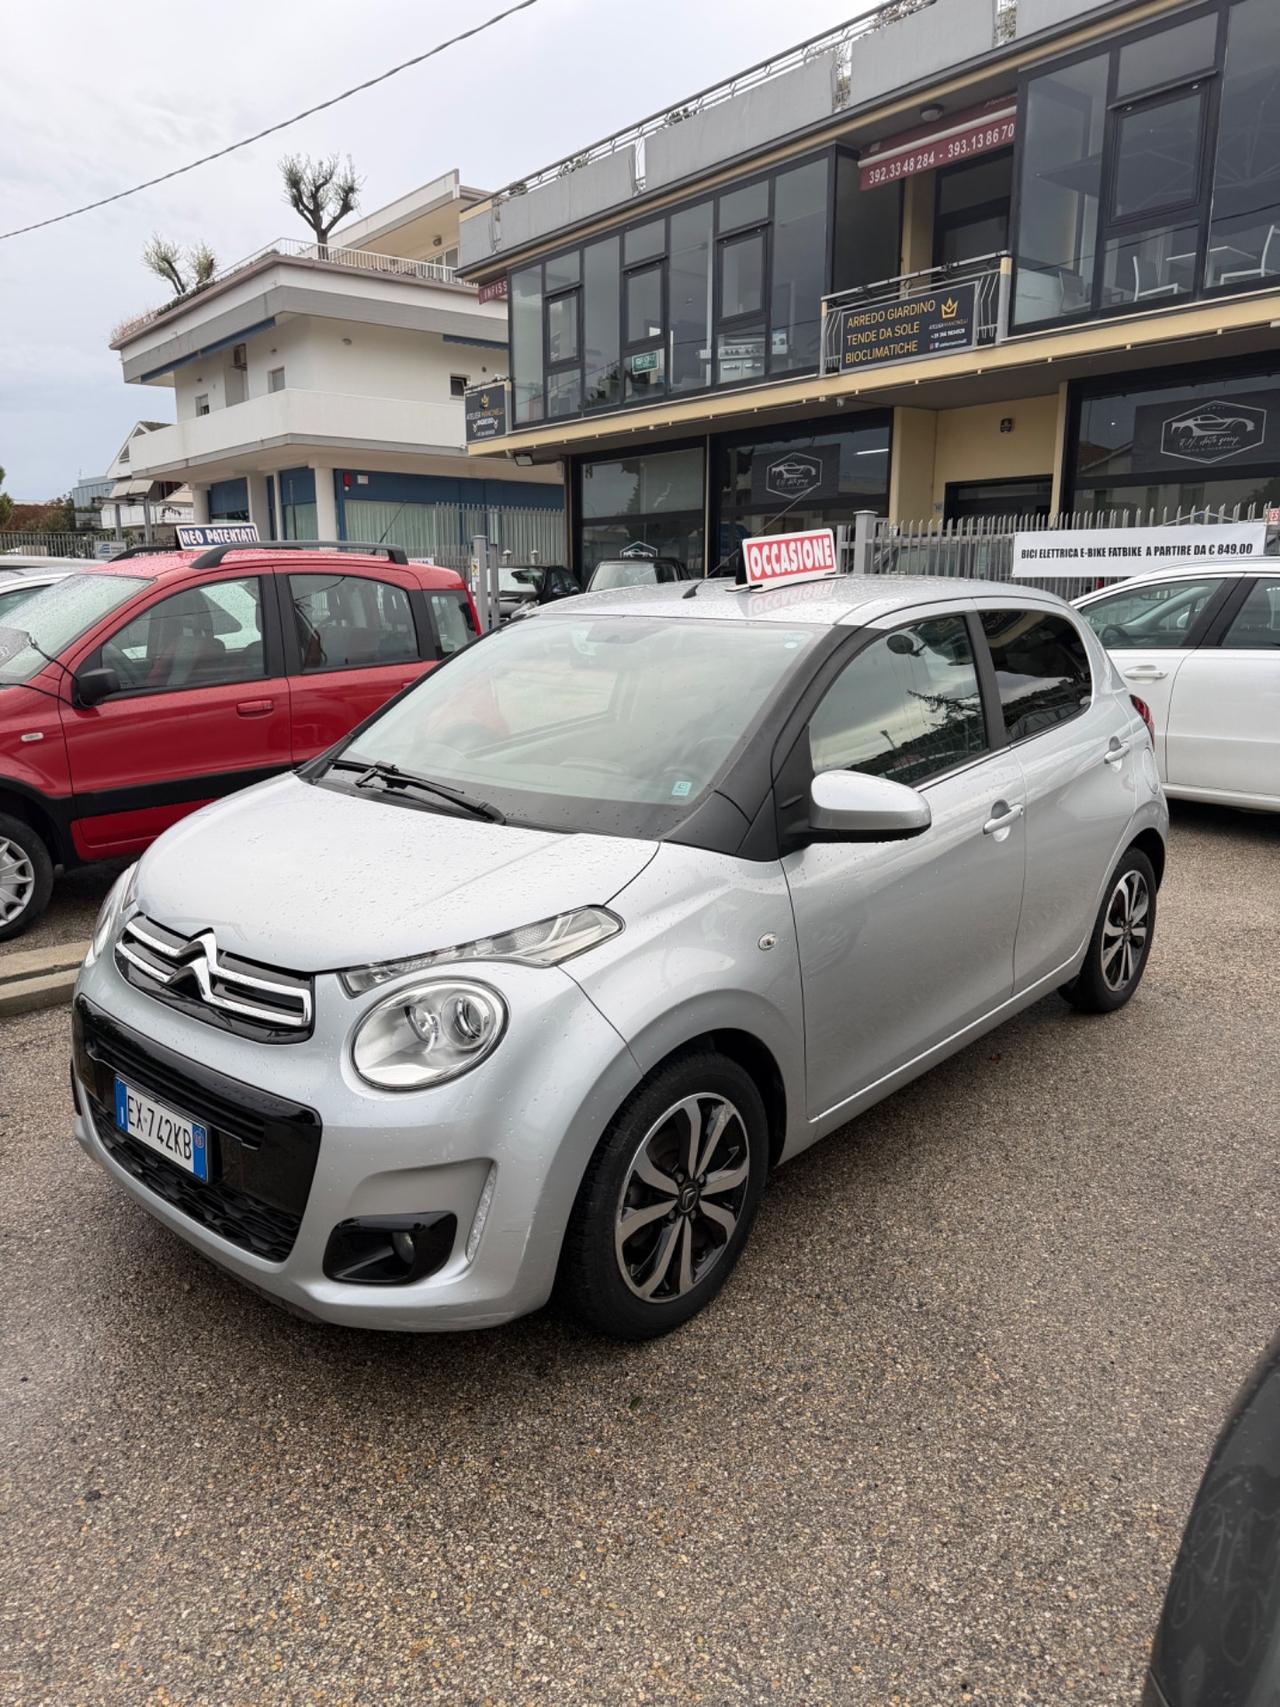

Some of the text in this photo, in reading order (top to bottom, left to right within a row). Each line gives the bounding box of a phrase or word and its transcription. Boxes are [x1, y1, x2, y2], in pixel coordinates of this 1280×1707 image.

[847, 299, 936, 329] ARREDO GIARDINO
[847, 321, 920, 346] TENDE DA SOLE
[845, 340, 918, 364] BIOCLIMATICHE
[180, 528, 257, 545] NEO PATENTATI
[750, 537, 833, 578] OCCASIONE
[1021, 548, 1037, 559] BICI
[1039, 547, 1079, 559] ELETTRICA
[1080, 547, 1107, 558] E-BIKE
[1108, 546, 1142, 557] FATBIKE
[1146, 545, 1152, 556] A
[1154, 544, 1193, 556] PARTIRE
[1194, 544, 1207, 555] DA
